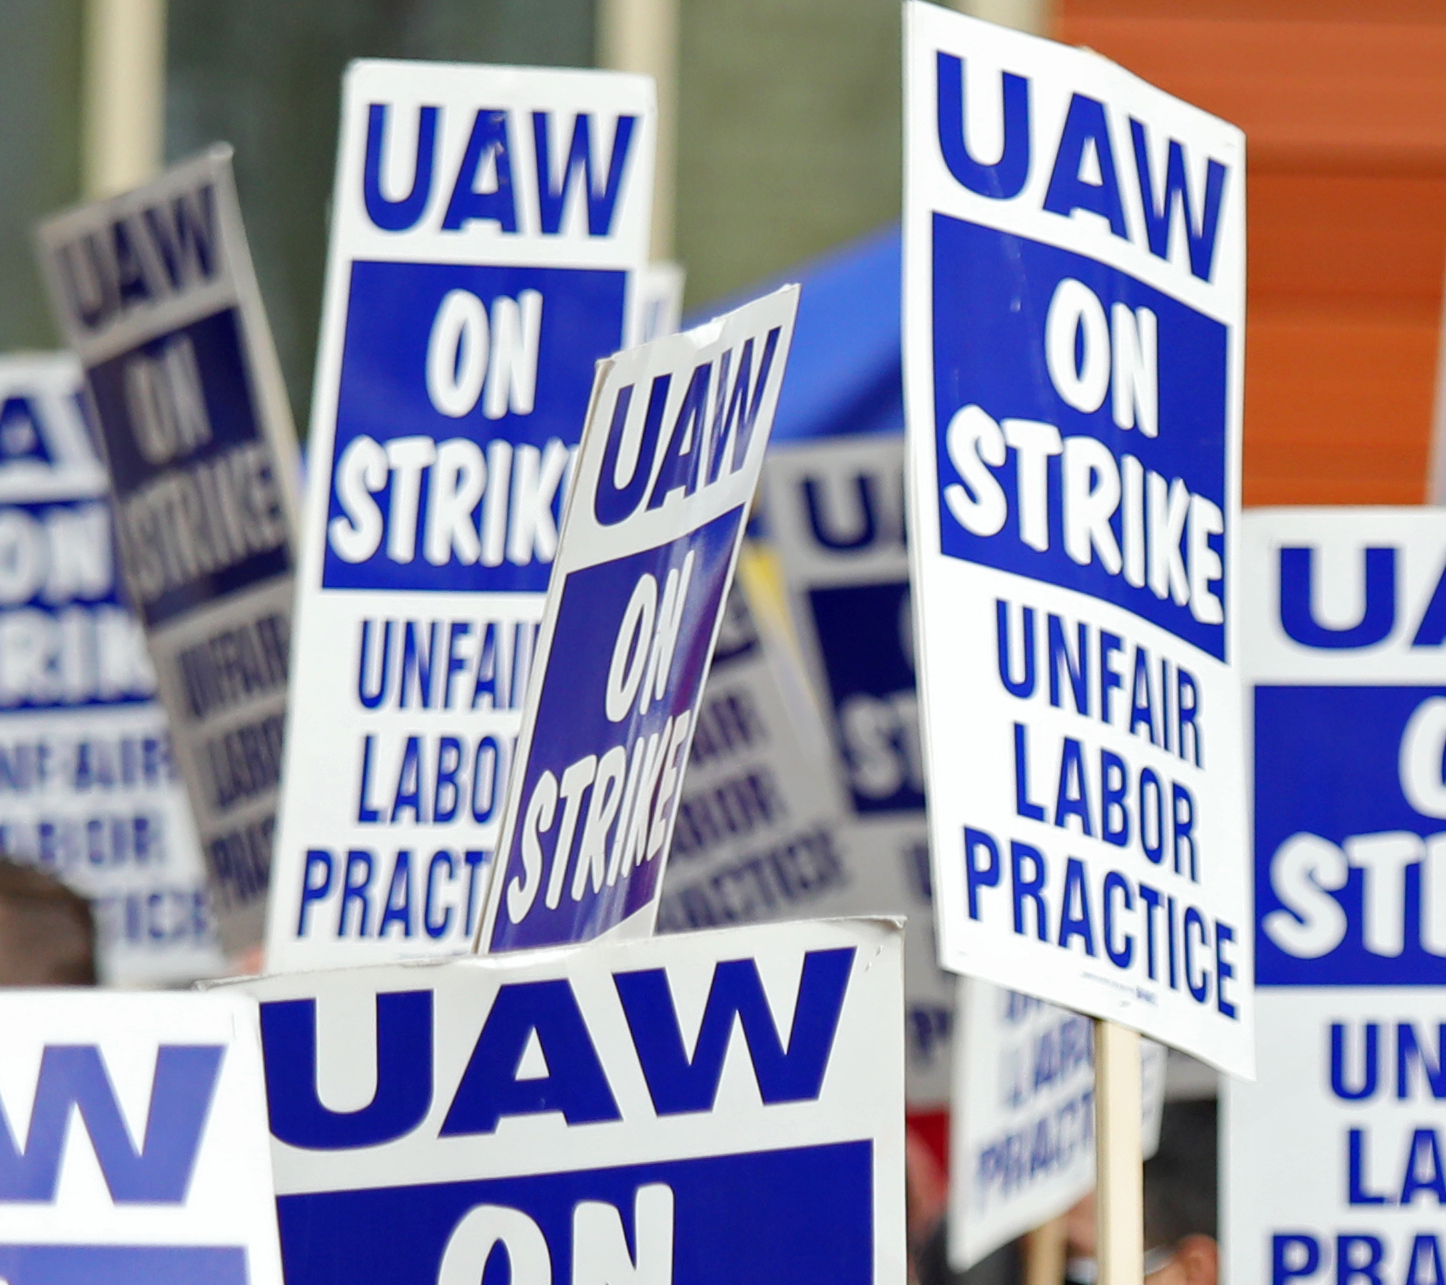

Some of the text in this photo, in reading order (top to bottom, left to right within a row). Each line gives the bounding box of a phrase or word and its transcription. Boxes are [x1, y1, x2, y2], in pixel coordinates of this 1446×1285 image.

[362, 103, 646, 238] UAW
[936, 50, 1228, 284] UAW
[58, 184, 220, 332] UAW
[124, 334, 211, 464] ON
[424, 288, 544, 420] ON
[592, 325, 784, 528] UAW
[1042, 277, 1160, 438] ON
[120, 438, 286, 602] STRIKE
[327, 436, 582, 568] STRIK
[944, 404, 1228, 626] STRIKE
[356, 618, 544, 712] UNFAI
[604, 550, 696, 724] ON
[994, 597, 1206, 770] UNFAIR
[354, 733, 520, 826] LABO
[504, 710, 692, 926] STRIKE
[1012, 721, 1202, 884] LABOR
[296, 848, 496, 942] PRACT
[962, 824, 1242, 1022] PRACTICE
[259, 944, 858, 1152] UAW
